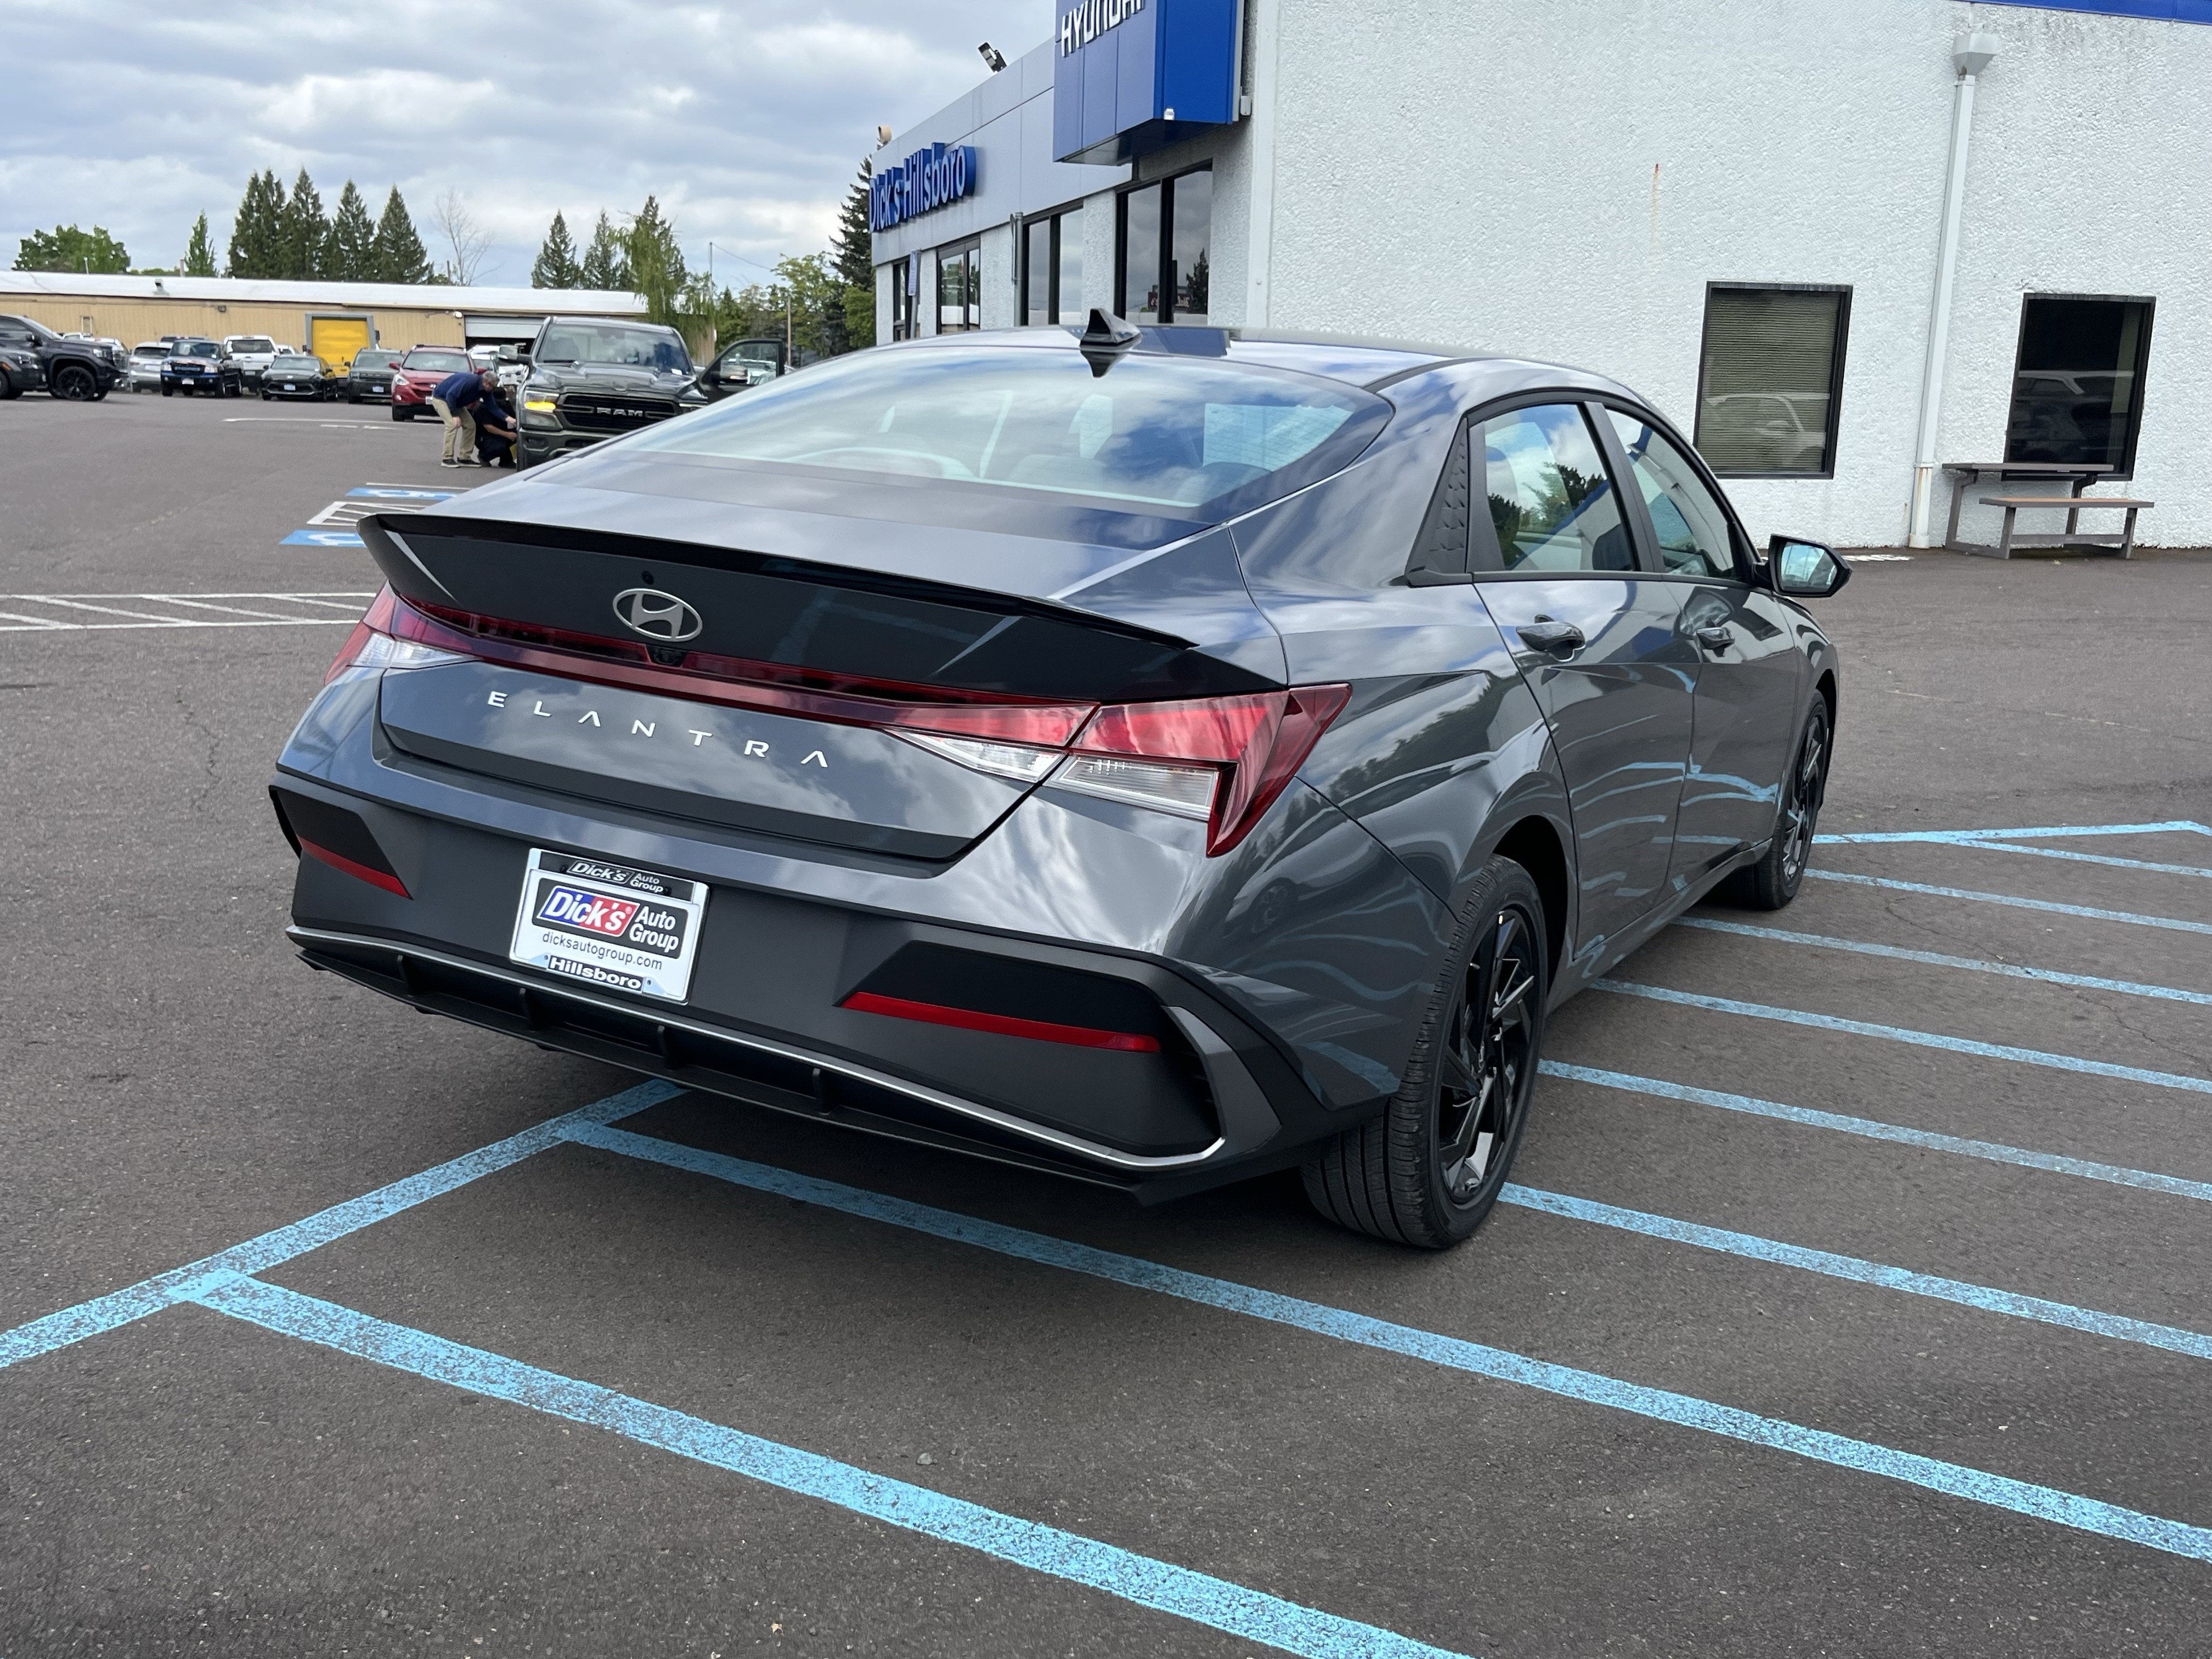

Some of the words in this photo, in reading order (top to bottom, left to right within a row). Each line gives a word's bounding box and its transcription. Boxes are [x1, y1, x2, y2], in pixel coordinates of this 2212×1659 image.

[1062, 0, 1144, 57] HYUND
[870, 166, 900, 232] Dick's
[904, 142, 966, 219] Hillsboro
[596, 407, 643, 417] RAM
[488, 691, 828, 768] ELANTRA
[572, 862, 627, 882] Dick's
[634, 873, 660, 884] Auto
[630, 879, 664, 894] Group
[545, 891, 626, 931] Dick's
[635, 906, 676, 930] Auto
[542, 932, 663, 970] dicksautogroup.com
[629, 923, 679, 953] Group
[549, 956, 641, 989] Hillsboro
